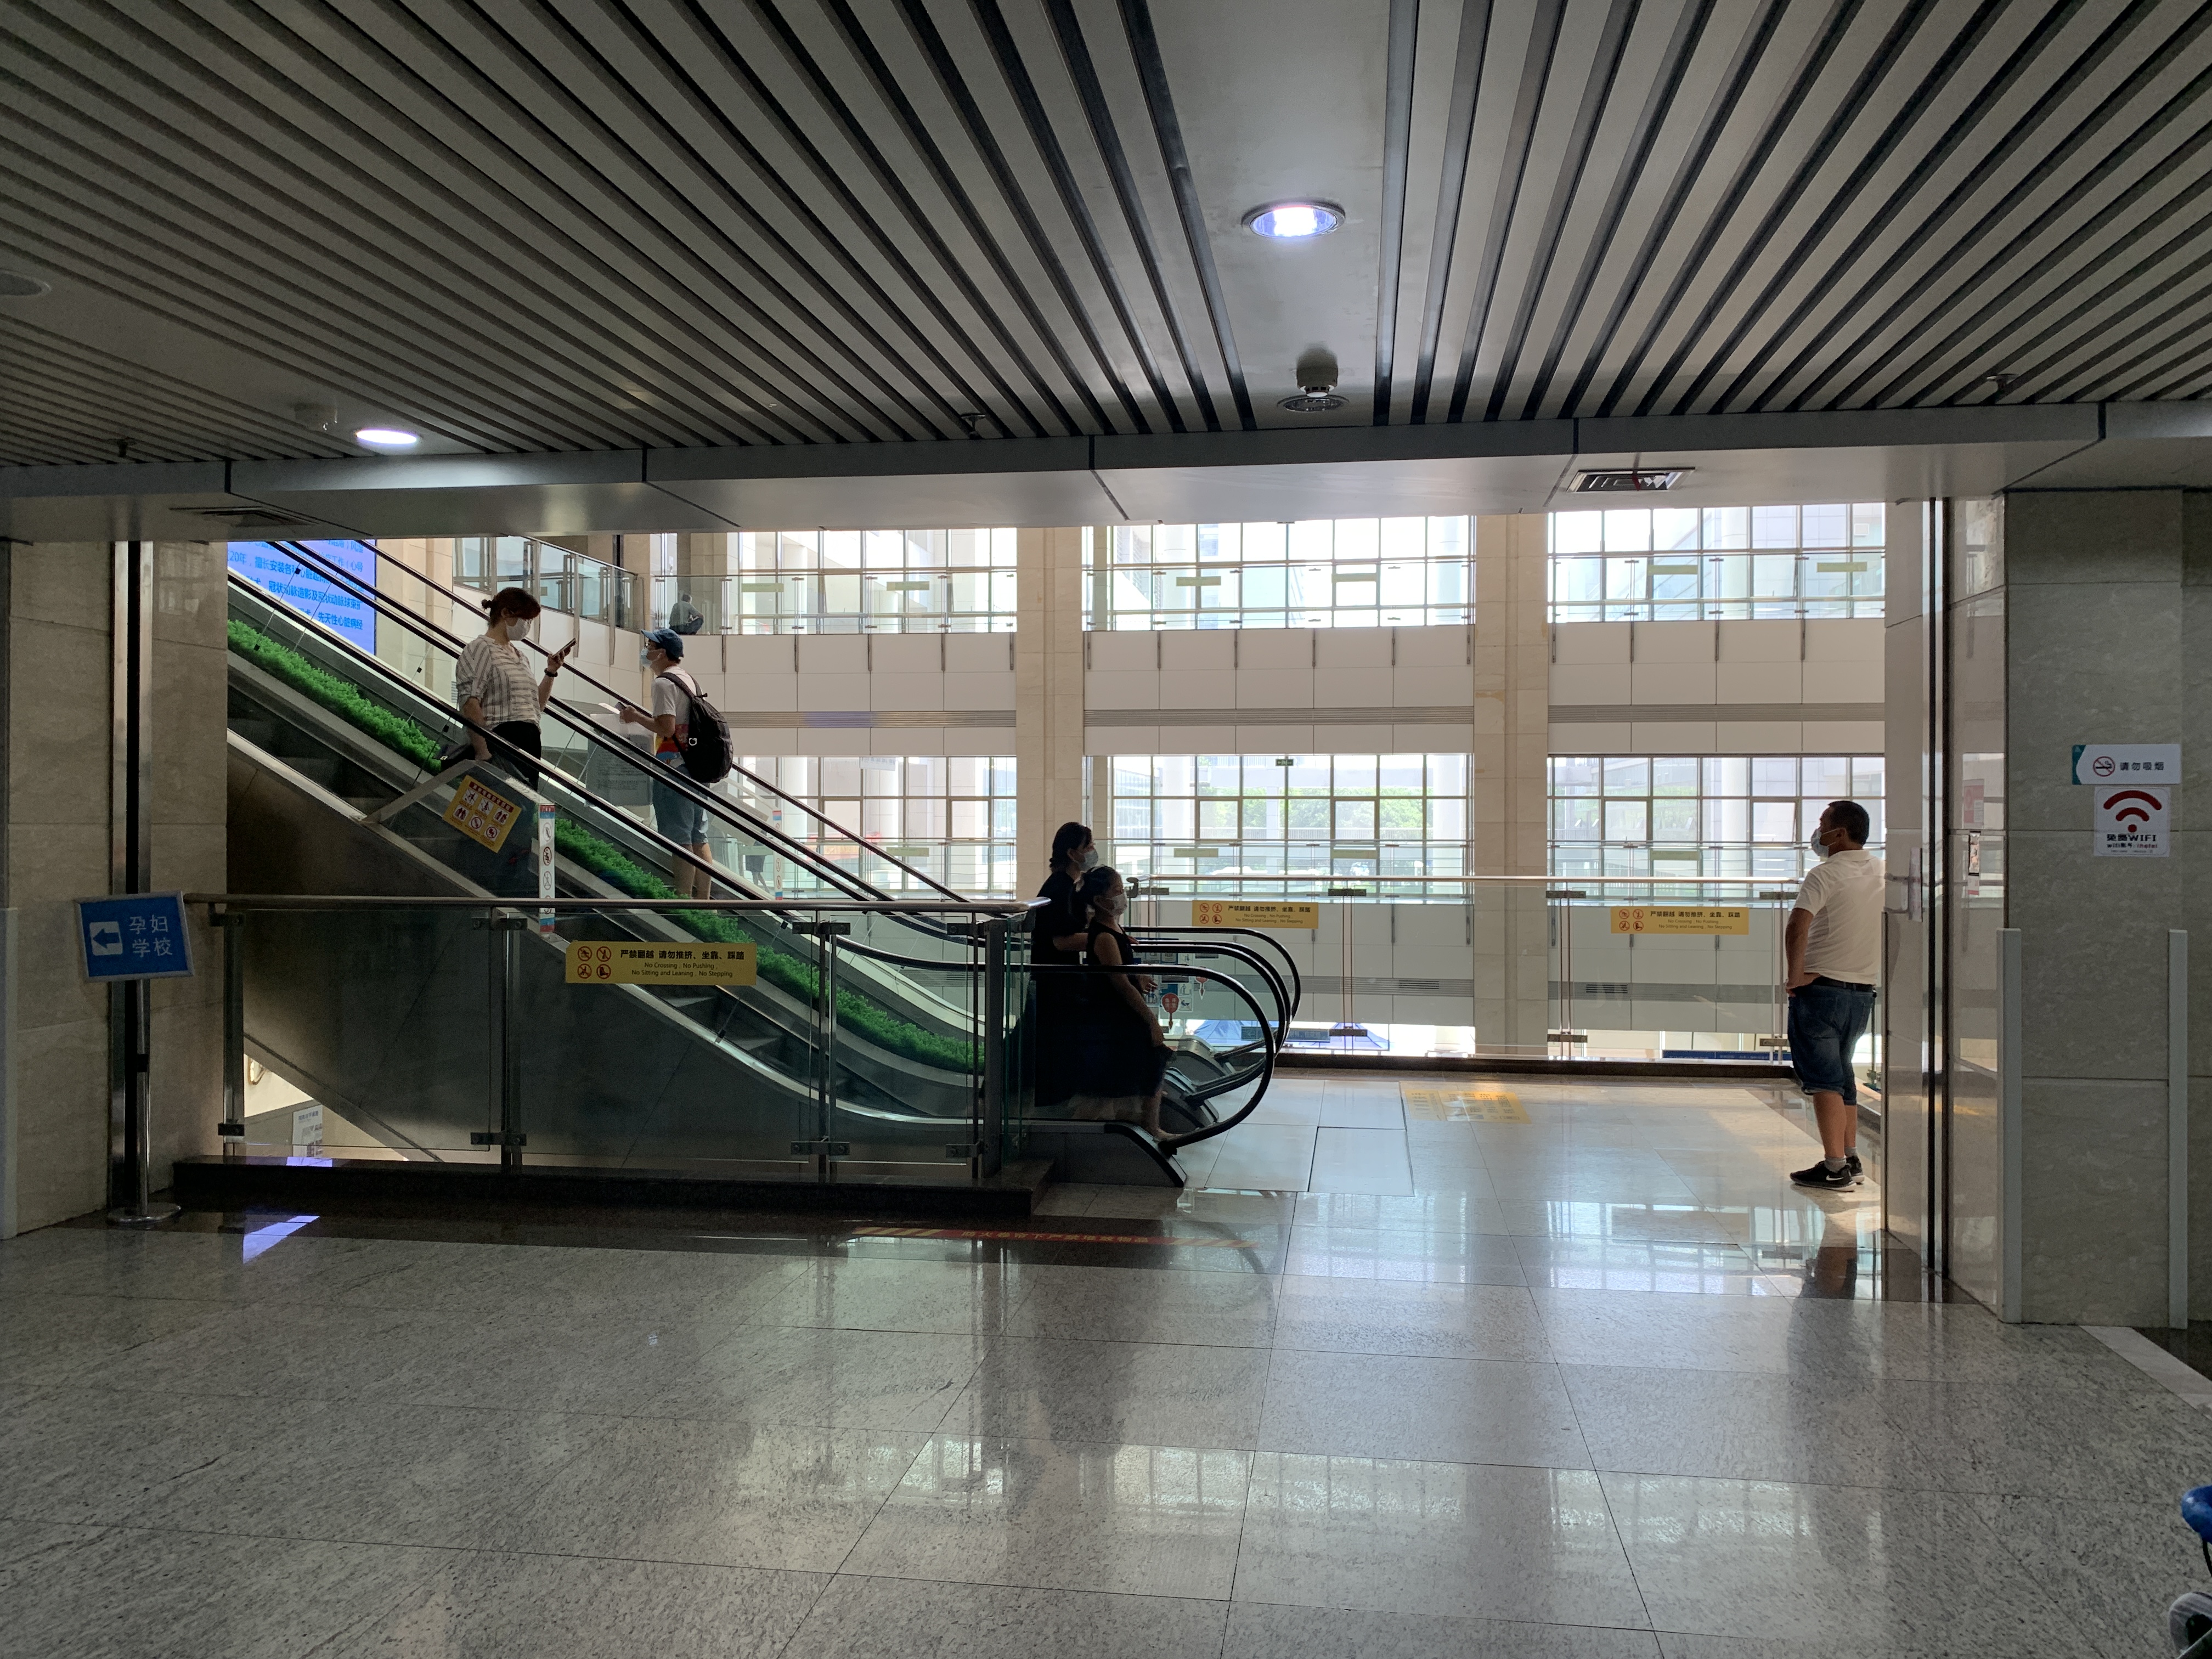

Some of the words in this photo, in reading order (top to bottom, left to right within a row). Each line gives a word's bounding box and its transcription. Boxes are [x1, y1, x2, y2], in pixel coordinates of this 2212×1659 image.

[2120, 761, 2164, 771] 请勿吸烟
[128, 914, 169, 935] 孕妇
[132, 937, 173, 958] 学校
[620, 949, 654, 958] 严禁翻越
